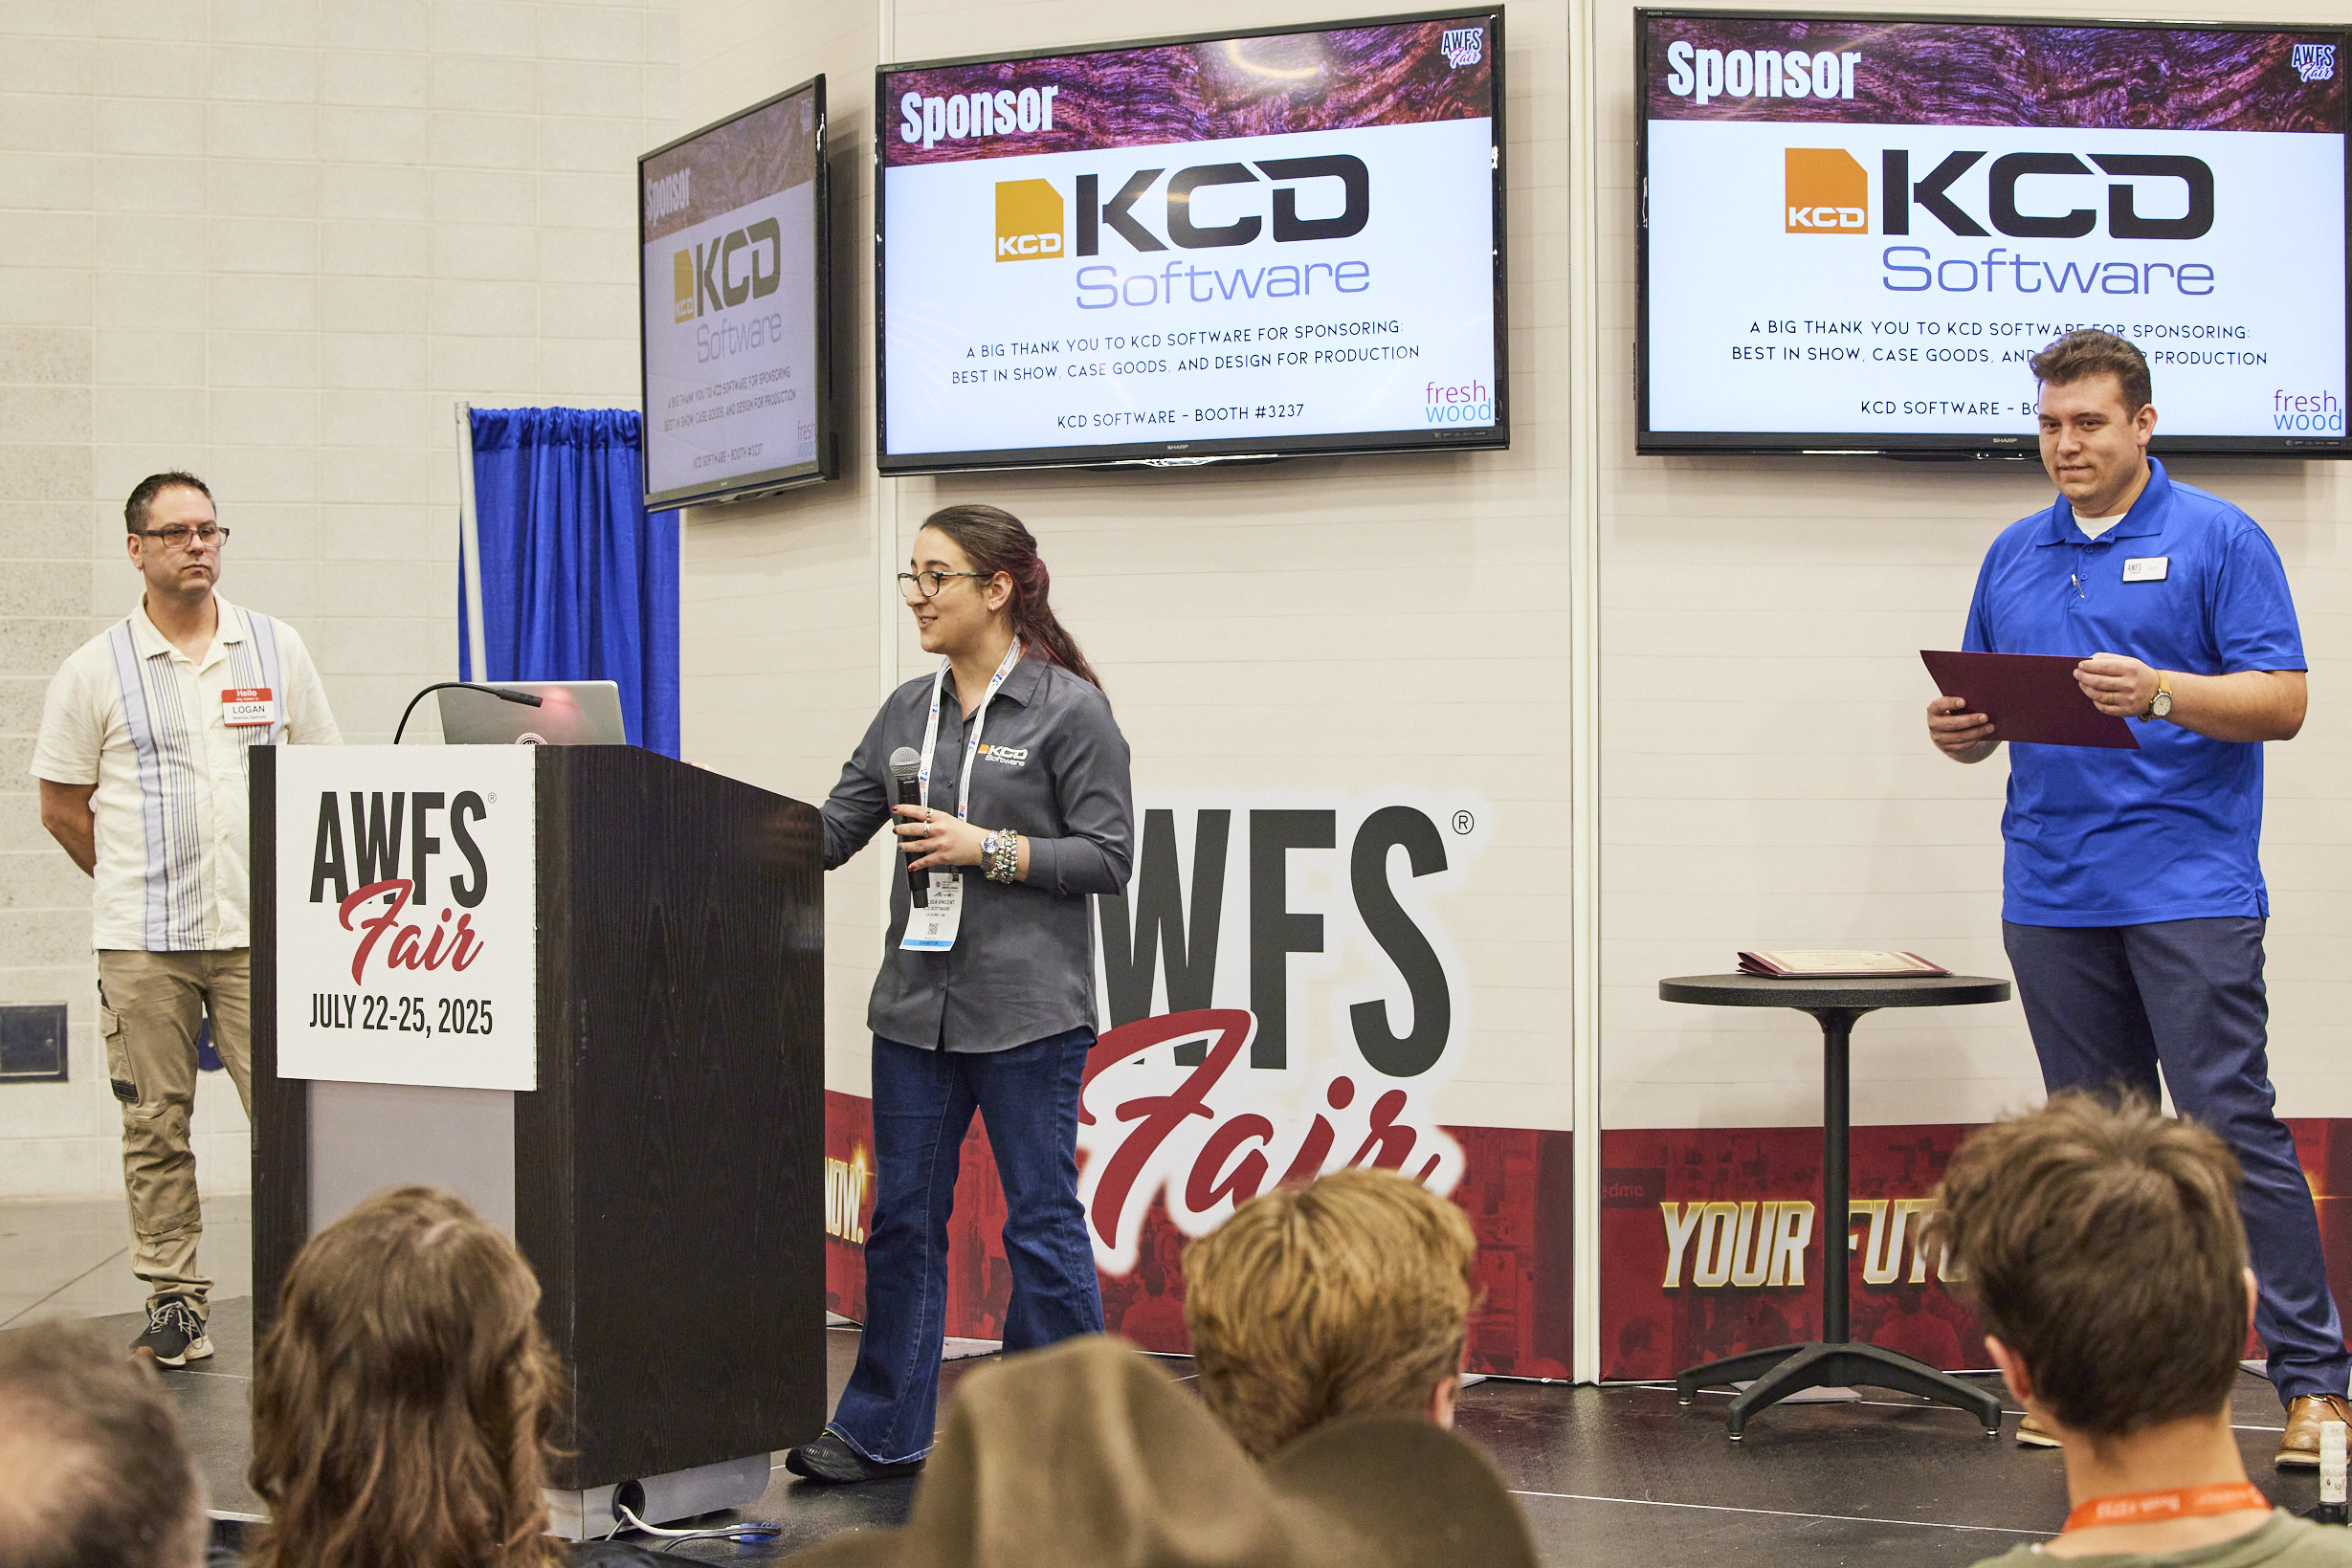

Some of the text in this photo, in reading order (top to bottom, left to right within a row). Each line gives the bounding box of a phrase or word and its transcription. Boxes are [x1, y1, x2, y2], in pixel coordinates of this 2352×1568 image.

[1443, 29, 1480, 54] AWFS
[1449, 46, 1478, 66] Fair
[2294, 45, 2333, 67] AWFS
[1667, 40, 1862, 105] Sponsor
[2300, 60, 2331, 79] Fair
[900, 84, 1059, 150] Sponsor
[646, 166, 692, 228] Sponsor
[1076, 153, 1370, 257] KCD
[1882, 148, 2215, 240] KCD
[1788, 206, 1866, 229] KCD
[998, 232, 1062, 256] KCD
[696, 216, 781, 318] KCD
[1882, 245, 2215, 296] Software
[1076, 259, 1370, 310] Software
[674, 297, 694, 319] KCD
[697, 312, 783, 364] Software
[966, 320, 1405, 359] A BIG THANK YOU TO KCD SOFTWARE FOR SPONSORING:
[1750, 320, 1761, 334] A
[1768, 320, 1797, 334] BIG
[1804, 320, 1863, 334] THANK
[1871, 320, 1910, 335] YOU
[1917, 321, 1941, 335] TO
[1947, 322, 1983, 336] KCD
[2133, 324, 2251, 339] SPONSORING:
[952, 345, 1419, 384] BEST IN SHOW, CASE GOODS, AND DESIGN FOR PRODUCTION
[1732, 346, 1776, 360] BEST
[1784, 346, 1800, 361] IN
[1808, 347, 1866, 363] SHOW,
[1873, 348, 1919, 362] CASE
[1926, 348, 1994, 364] GOODS,
[2155, 351, 2268, 365] PRODUCTION
[679, 392, 695, 406] THANK
[696, 388, 705, 402] YOU
[713, 385, 722, 397] KCD
[722, 377, 748, 395] SOFTWARE
[748, 374, 759, 387] FOR
[1425, 379, 1486, 404] fresh
[2273, 388, 2337, 412] fresh
[664, 418, 675, 431] BEST
[696, 409, 707, 424] CASE
[726, 403, 736, 417] AND
[736, 399, 754, 414] DESIGN
[754, 395, 765, 409] FOR
[765, 388, 797, 407] PRODUCTION
[1057, 414, 1088, 429] KCD
[1093, 410, 1176, 427] SOFTWARE
[1195, 407, 1249, 422] BOOTH
[1254, 404, 1304, 419] #3237
[1425, 397, 1492, 423] wood
[1861, 401, 1897, 414] KCD
[1903, 401, 2000, 415] SOFTWARE
[2273, 408, 2342, 431] wood
[702, 451, 727, 467] SOFTWARE
[730, 446, 747, 461] BOOTH
[233, 705, 265, 714] LOGAN
[985, 753, 1026, 767] Software
[987, 744, 1029, 761] KCD
[309, 789, 488, 909] AWFS
[339, 878, 484, 986] Fair
[1097, 806, 1452, 1078] WFS
[309, 993, 493, 1039] JULY 22-25, 2025
[1659, 1200, 1815, 1289] YOUR
